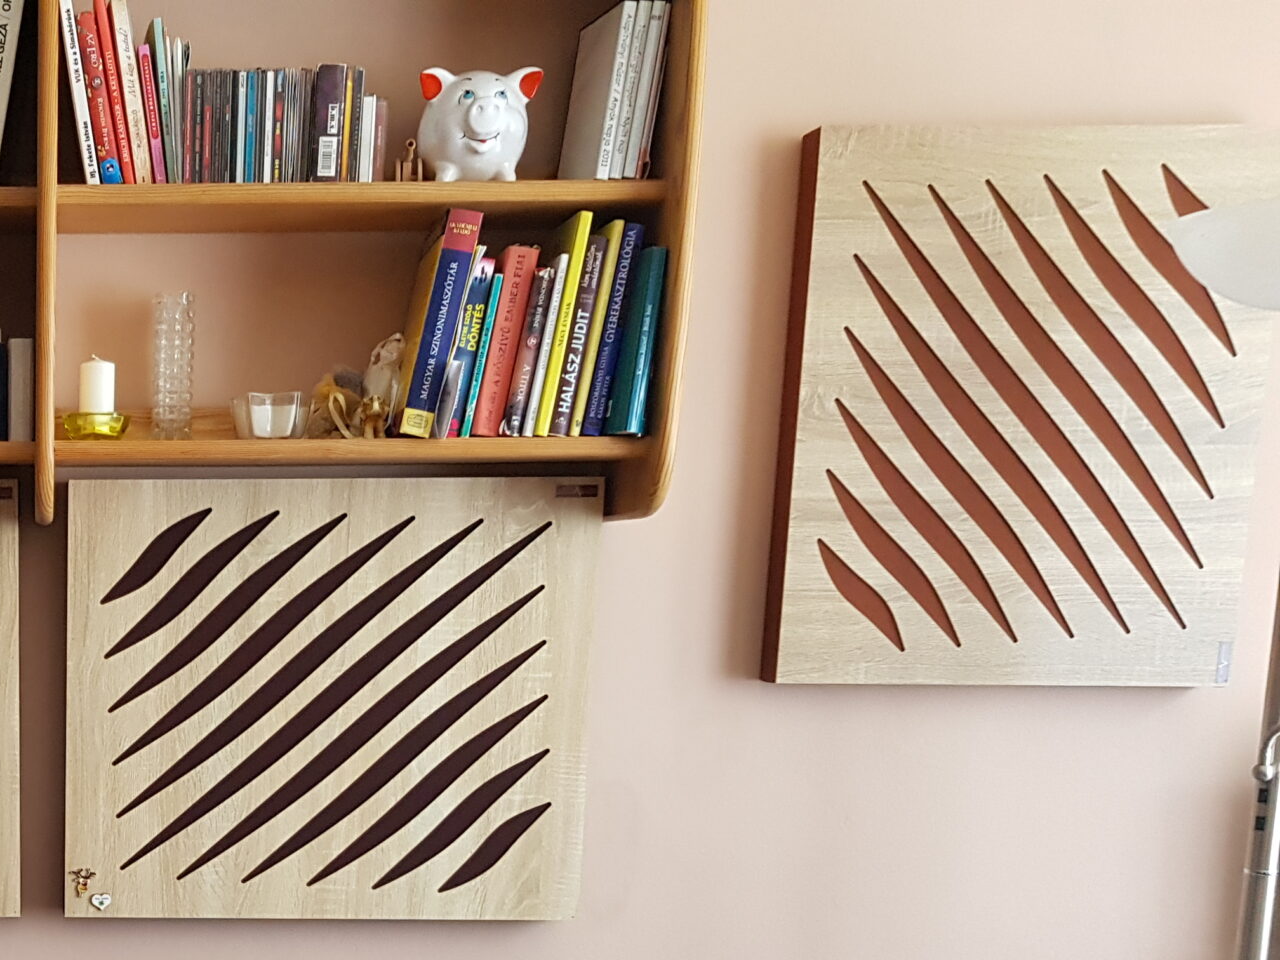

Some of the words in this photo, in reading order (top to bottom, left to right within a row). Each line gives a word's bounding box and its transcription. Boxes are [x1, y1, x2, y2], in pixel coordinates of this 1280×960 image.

[86, 30, 95, 45] AZ
[73, 57, 78, 66] és
[127, 78, 136, 97] Mit
[609, 96, 618, 121] Anyák
[602, 123, 613, 146] napja
[120, 139, 129, 162] ERICH
[600, 148, 609, 167] 2011
[504, 282, 519, 322] EMBER
[513, 254, 525, 277] FIAI
[605, 229, 636, 343] GYEREKASZTROLÓGIA
[420, 357, 435, 399] MAGYAR
[431, 261, 459, 356] SZINONIMASZÓTÁR
[467, 303, 483, 350] DÖNTÉS
[559, 353, 580, 413] HALÁSZ
[572, 308, 590, 350] JUDIT
[516, 373, 529, 402] TITOK
